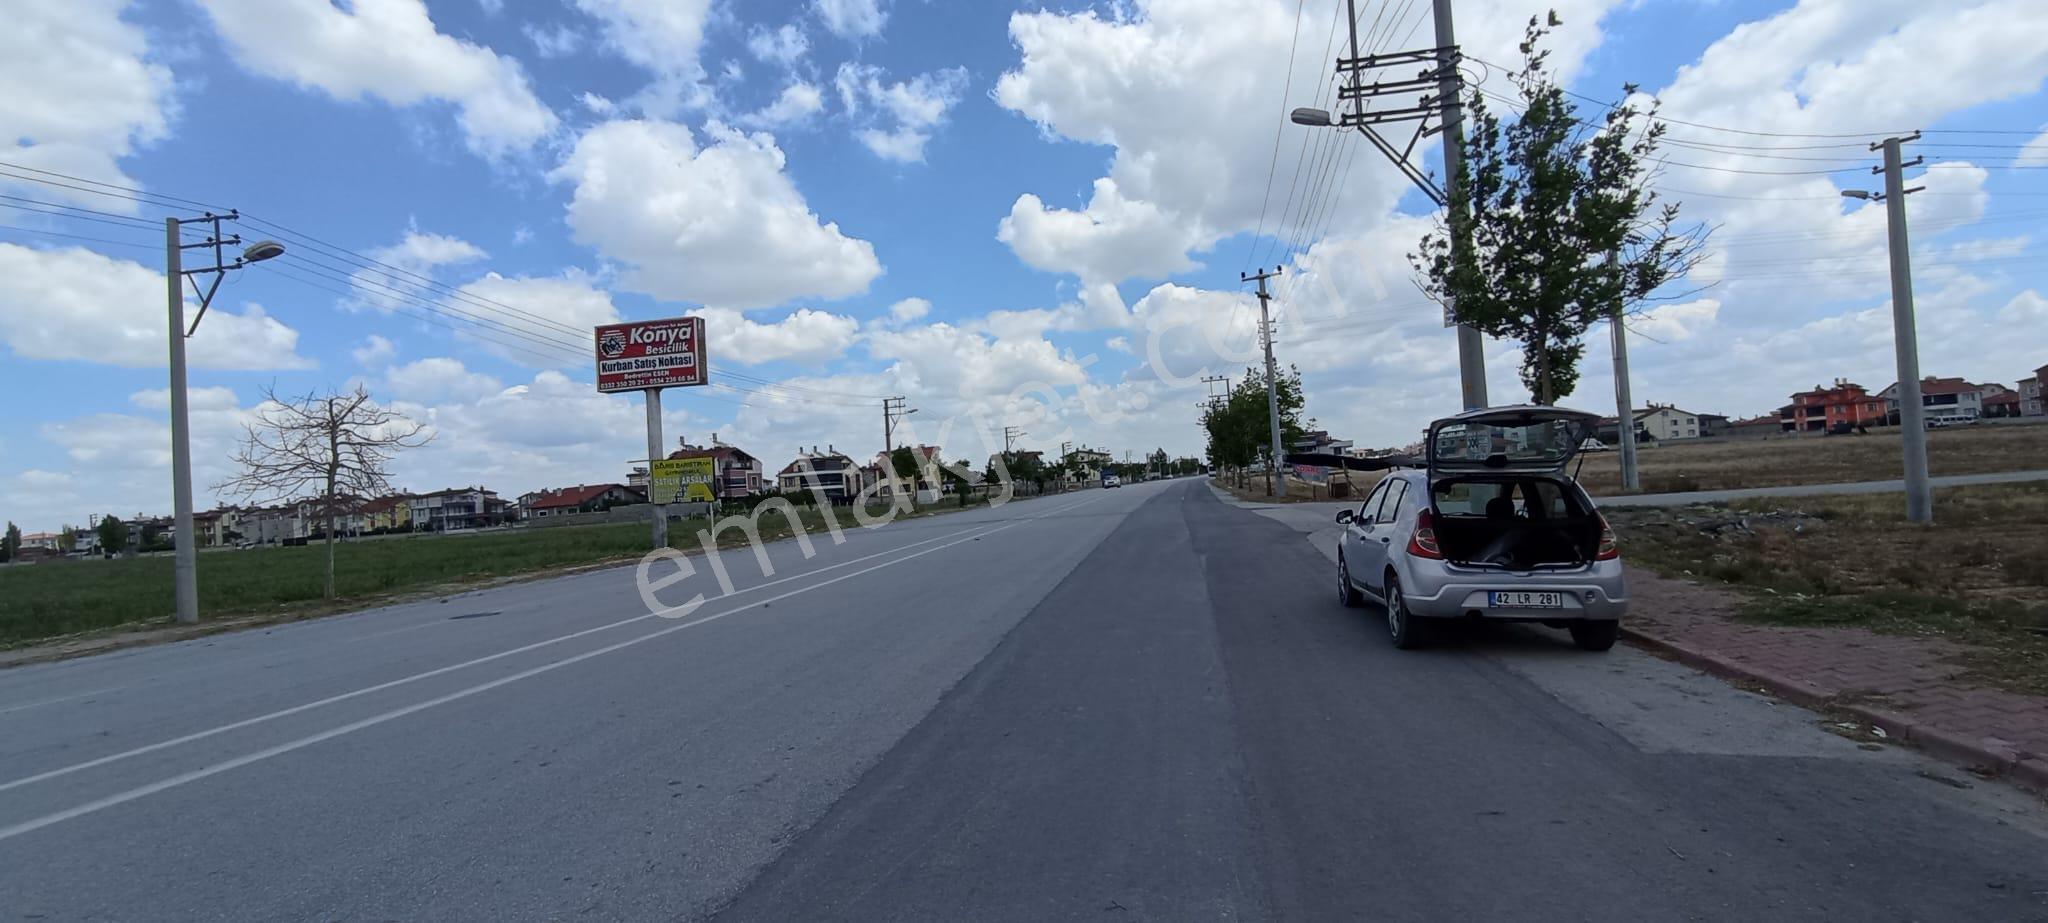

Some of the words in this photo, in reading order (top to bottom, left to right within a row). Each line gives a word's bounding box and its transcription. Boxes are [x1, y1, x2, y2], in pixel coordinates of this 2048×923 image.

[630, 325, 691, 345] Konya
[646, 342, 688, 355] Besicilik
[601, 361, 633, 373] Kurban
[634, 358, 657, 370] Satış
[659, 355, 692, 367] Noktası
[1497, 593, 1509, 604] 42
[1517, 594, 1531, 604] LR
[1540, 594, 1558, 604] 281
